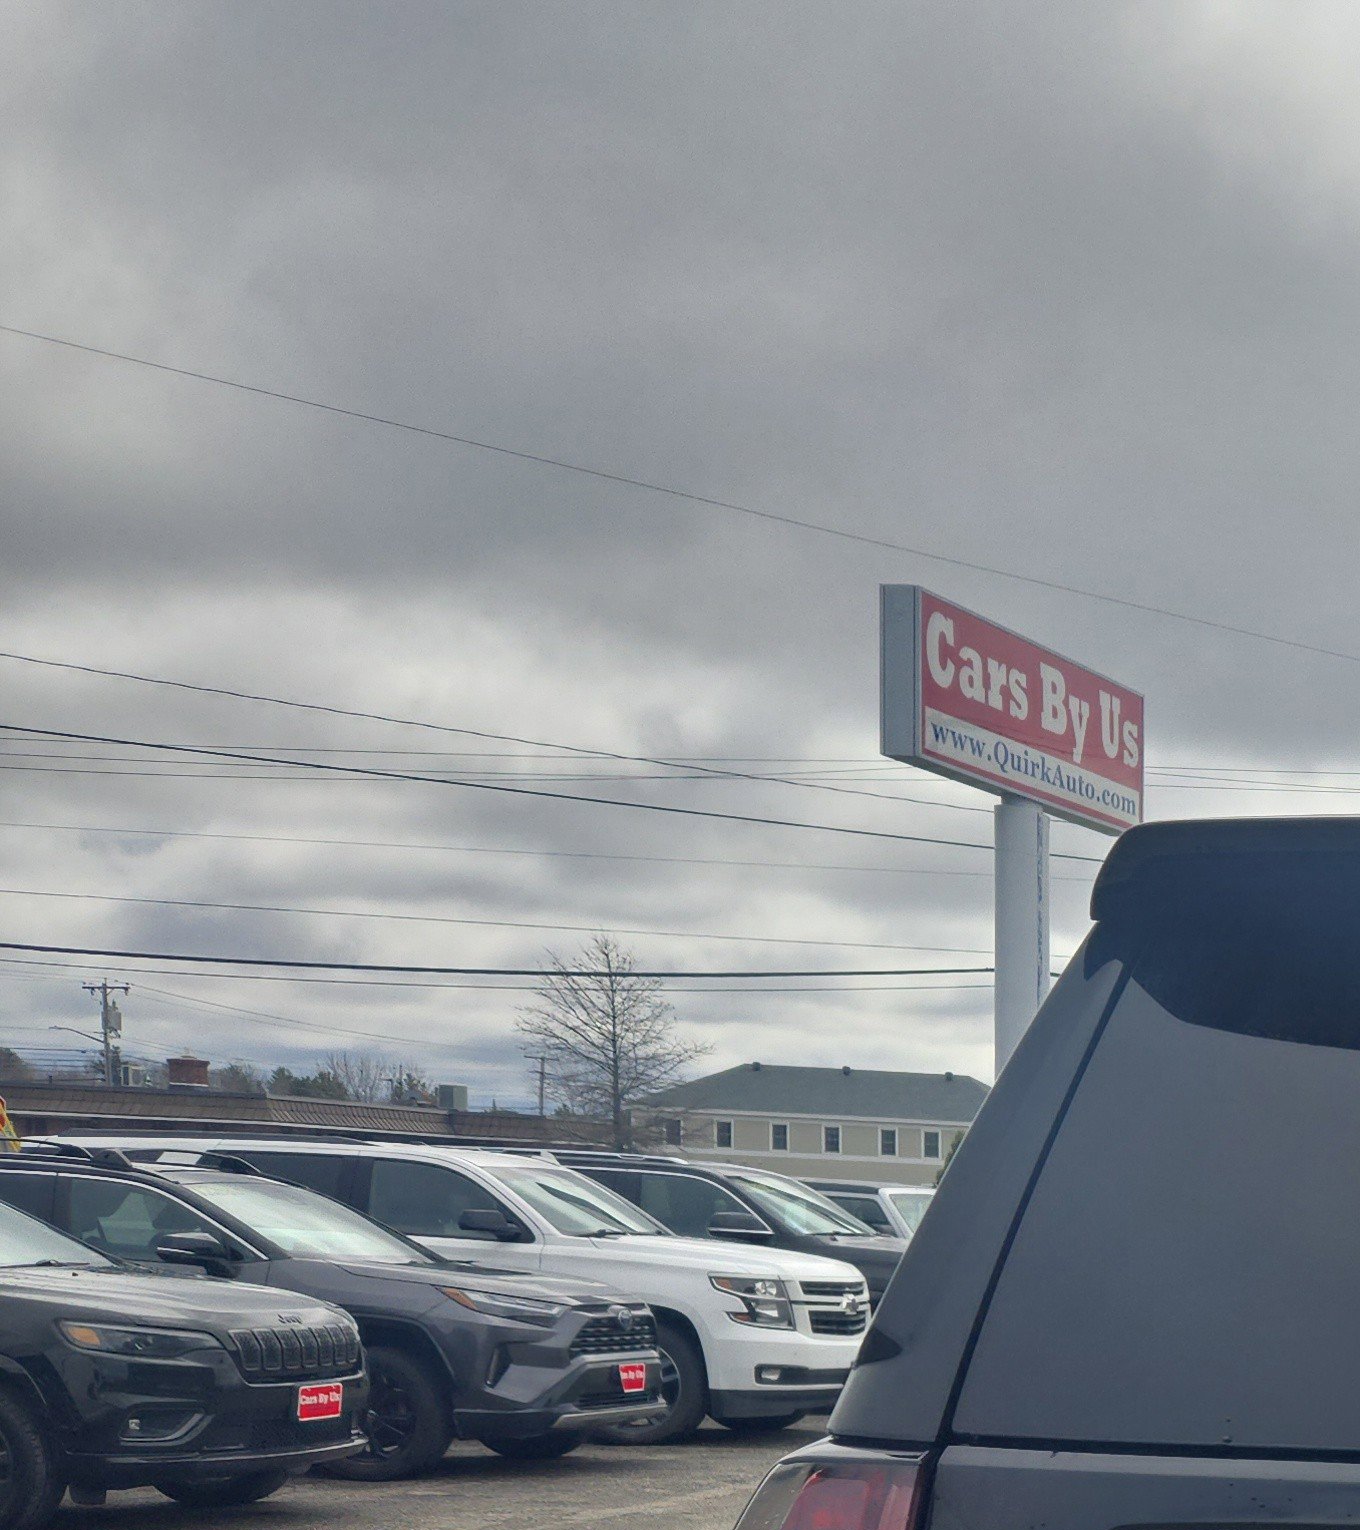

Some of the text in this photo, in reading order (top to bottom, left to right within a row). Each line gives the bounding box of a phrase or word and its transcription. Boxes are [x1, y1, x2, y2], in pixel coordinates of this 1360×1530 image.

[926, 611, 1139, 768] Cars By Us
[930, 721, 1137, 816] www.QuirkAuto.com
[318, 1392, 329, 1405] By
